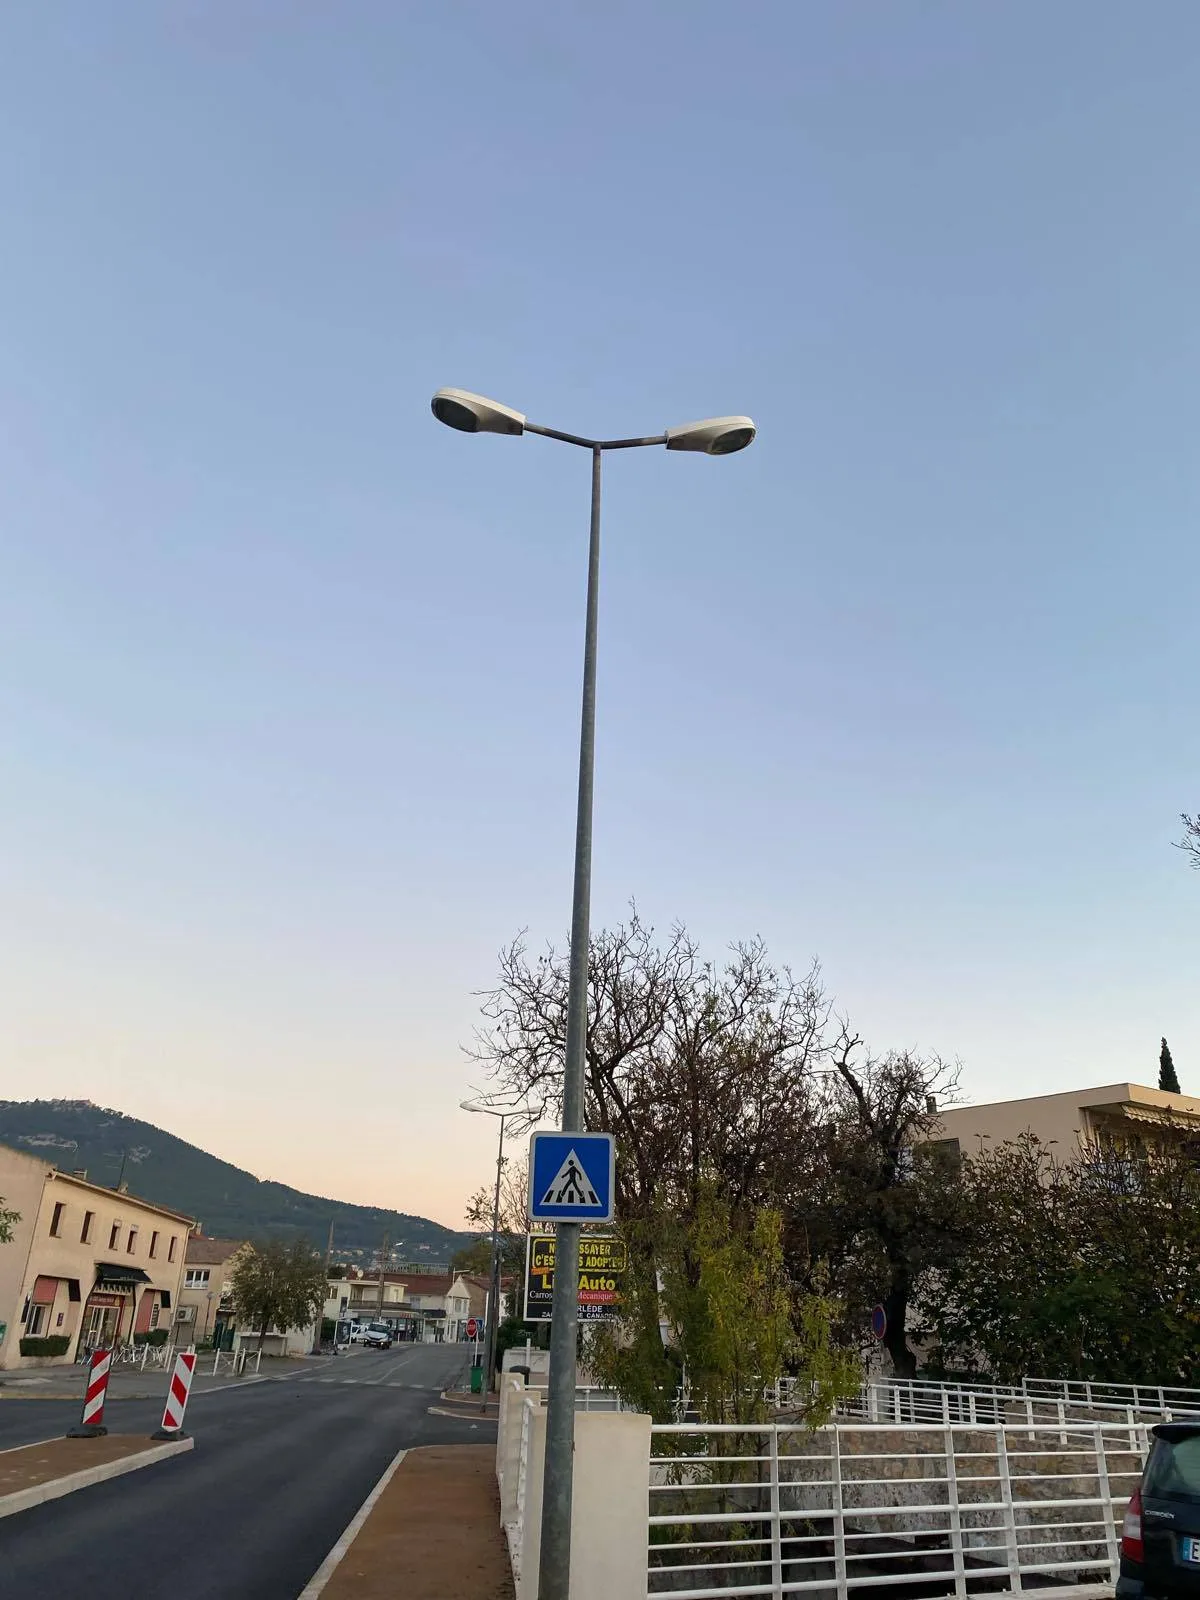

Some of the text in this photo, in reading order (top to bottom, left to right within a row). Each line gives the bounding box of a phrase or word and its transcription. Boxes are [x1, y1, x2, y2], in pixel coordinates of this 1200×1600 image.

[579, 1244, 611, 1255] SSAYER
[535, 1254, 555, 1266] C'ES
[578, 1275, 616, 1290] Auto
[530, 1290, 553, 1300] Carros
